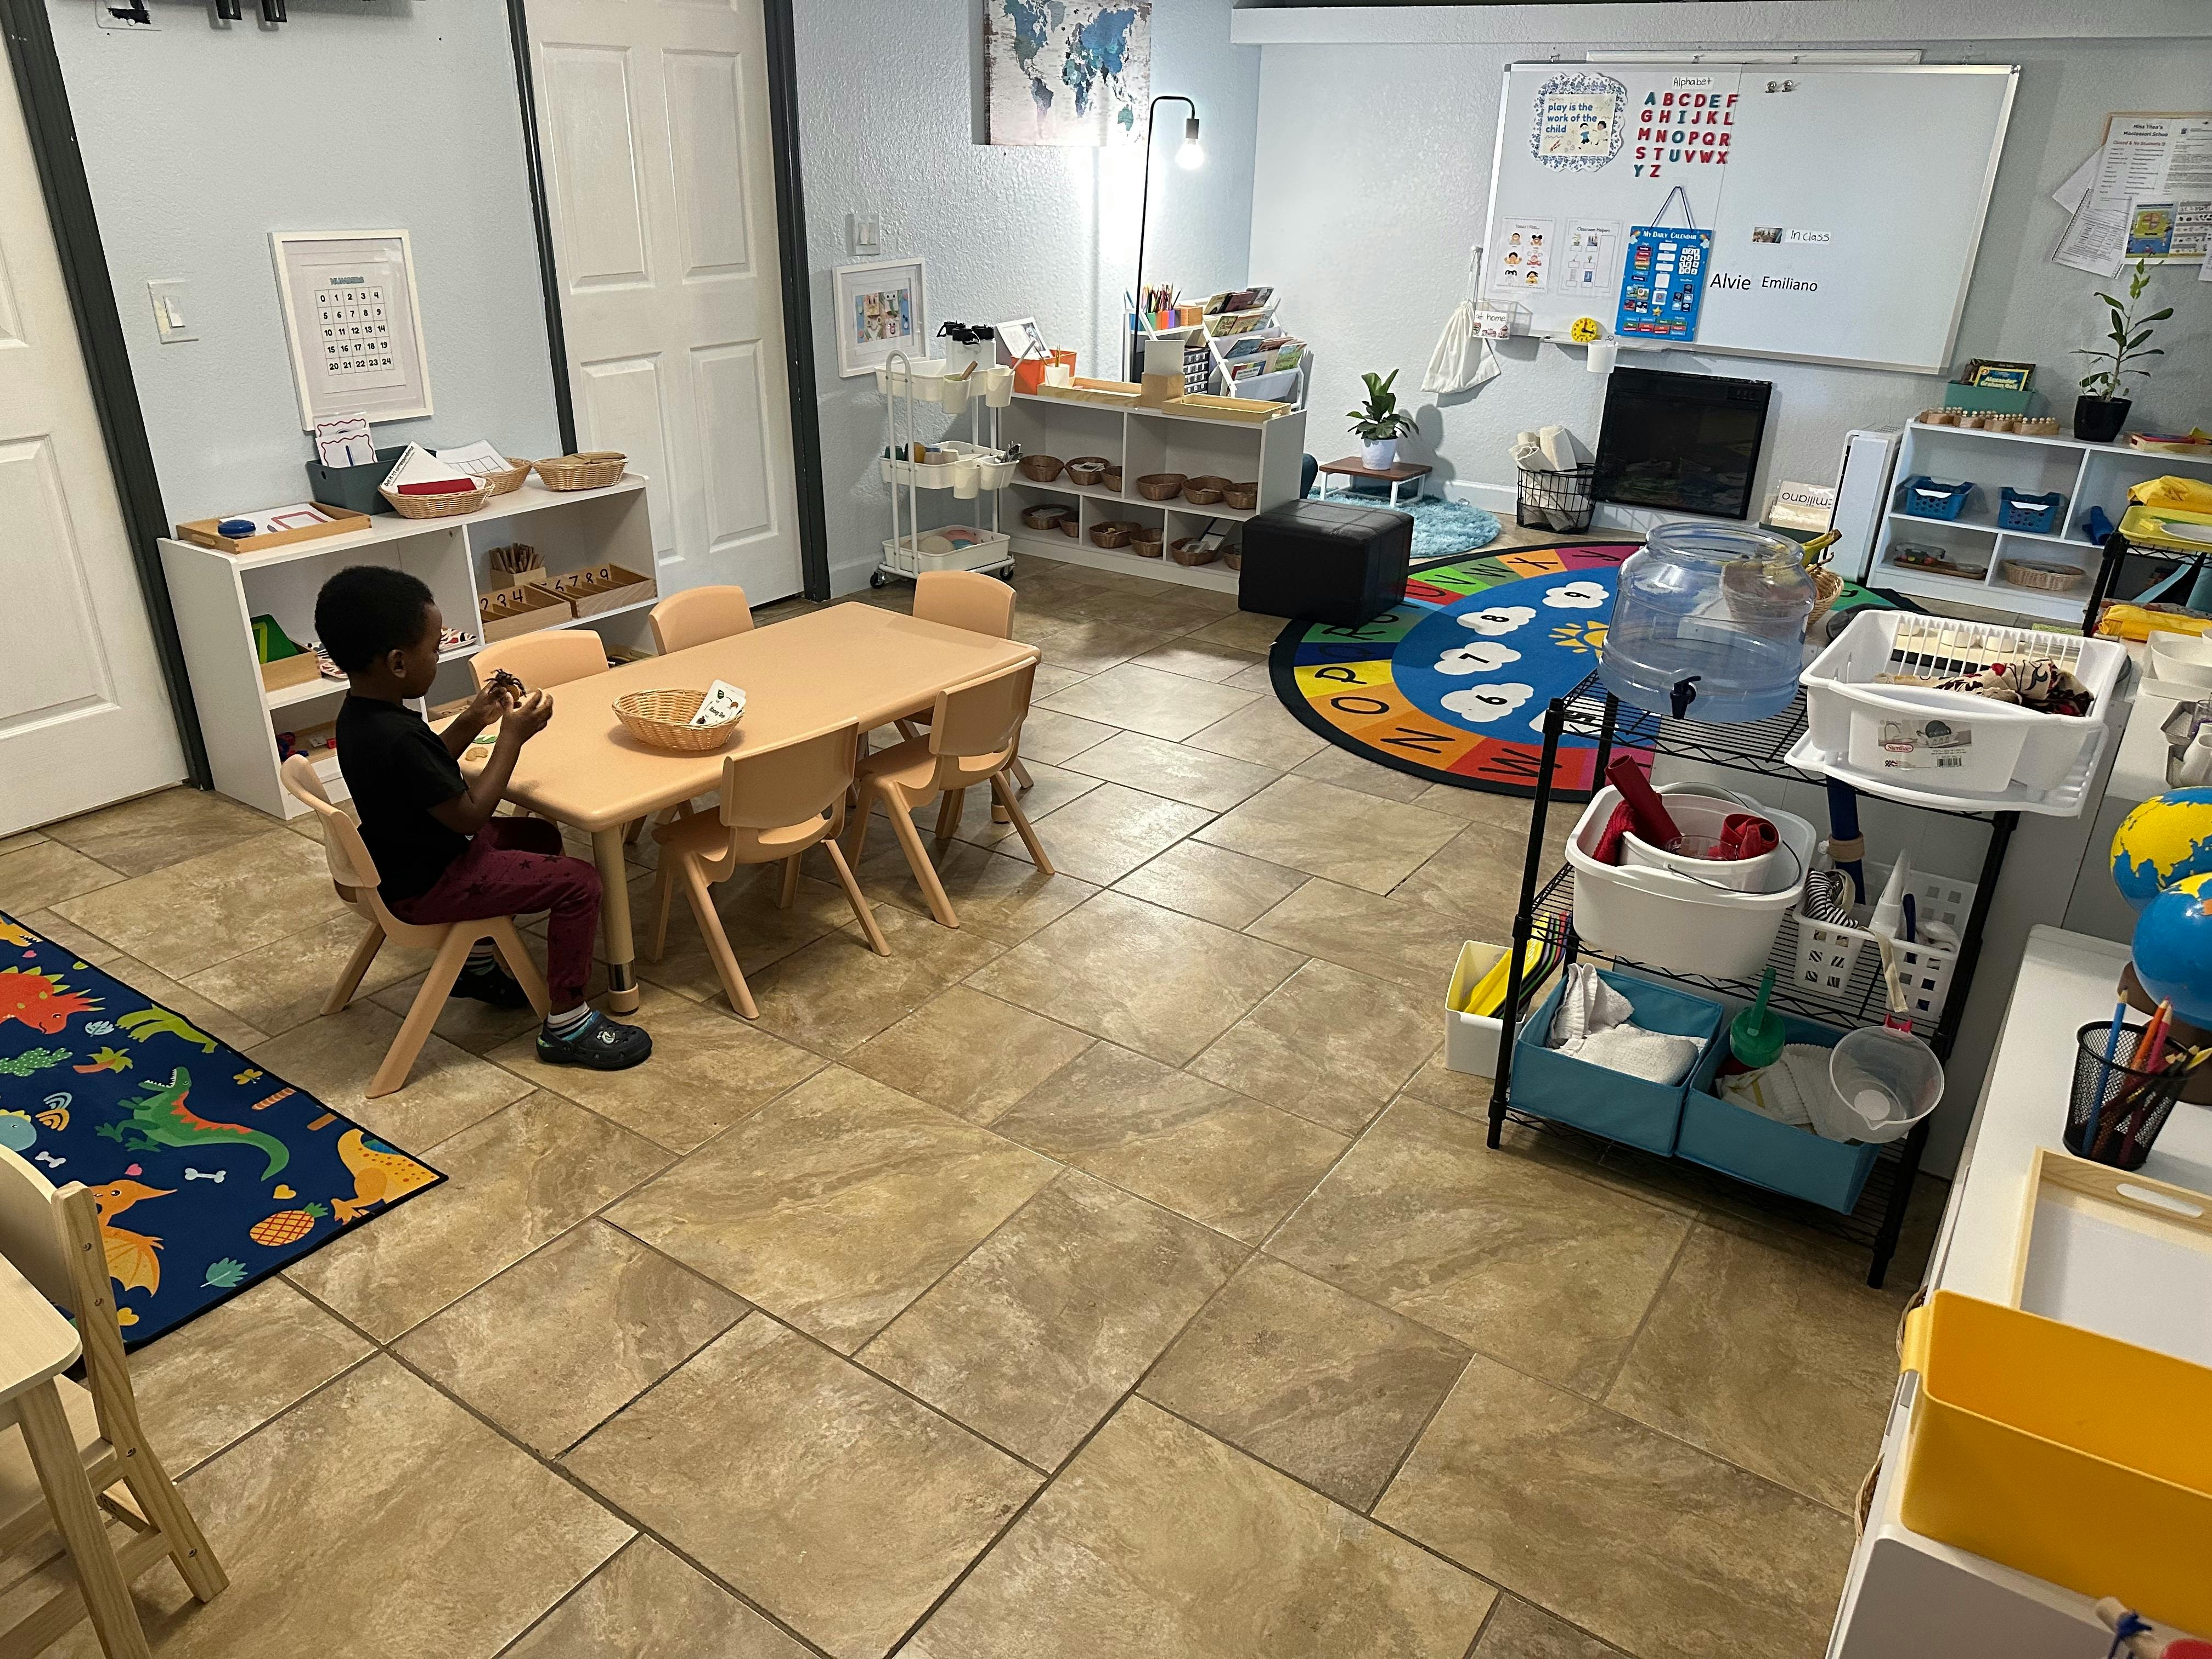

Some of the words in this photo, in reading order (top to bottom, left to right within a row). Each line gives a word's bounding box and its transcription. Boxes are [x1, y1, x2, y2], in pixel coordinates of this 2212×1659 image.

[1673, 77, 1712, 89] Alphabet
[1548, 103, 1567, 112] play
[1578, 103, 1593, 111] the
[1644, 92, 1656, 105] A
[1663, 93, 1673, 106] B
[1679, 93, 1691, 106] C
[1694, 94, 1706, 107] D
[1709, 94, 1721, 108] E
[1726, 94, 1739, 108] F
[1641, 110, 1653, 122] G
[1659, 110, 1671, 123] H
[1677, 111, 1687, 123] I
[1691, 111, 1701, 124] J
[1706, 111, 1718, 124] K
[1724, 112, 1734, 125] L
[1546, 125, 1566, 133] child
[1638, 128, 1651, 140] M
[1656, 130, 1667, 142] N
[1672, 131, 1685, 143] O
[1688, 132, 1699, 144] P
[1702, 132, 1714, 145] Q
[1719, 133, 1730, 146] R
[1636, 146, 1646, 159] S
[1654, 148, 1664, 160] T
[1669, 149, 1681, 162] U
[1685, 150, 1695, 162] V
[1700, 150, 1714, 163] W
[1717, 151, 1728, 164] X
[1634, 164, 1644, 177] Y
[1650, 165, 1661, 177] Z
[1791, 230, 1801, 240] in
[1710, 273, 1751, 290] Alvie
[1762, 276, 1818, 291] Emiliano
[1487, 313, 1506, 321] home
[1462, 563, 1512, 579] W
[1506, 557, 1558, 570] X
[569, 575, 578, 586] 7
[586, 573, 594, 584] 8
[600, 568, 608, 580] 9
[1424, 574, 1476, 585] V
[481, 597, 488, 610] 2
[497, 594, 506, 607] 3
[512, 589, 522, 602] 4
[1321, 624, 1386, 641] R
[1458, 652, 1490, 664] 7
[1480, 614, 1510, 623] 8
[1314, 667, 1368, 685] P
[1330, 696, 1390, 715] O
[1380, 727, 1456, 754] N
[1477, 747, 1563, 777] M
